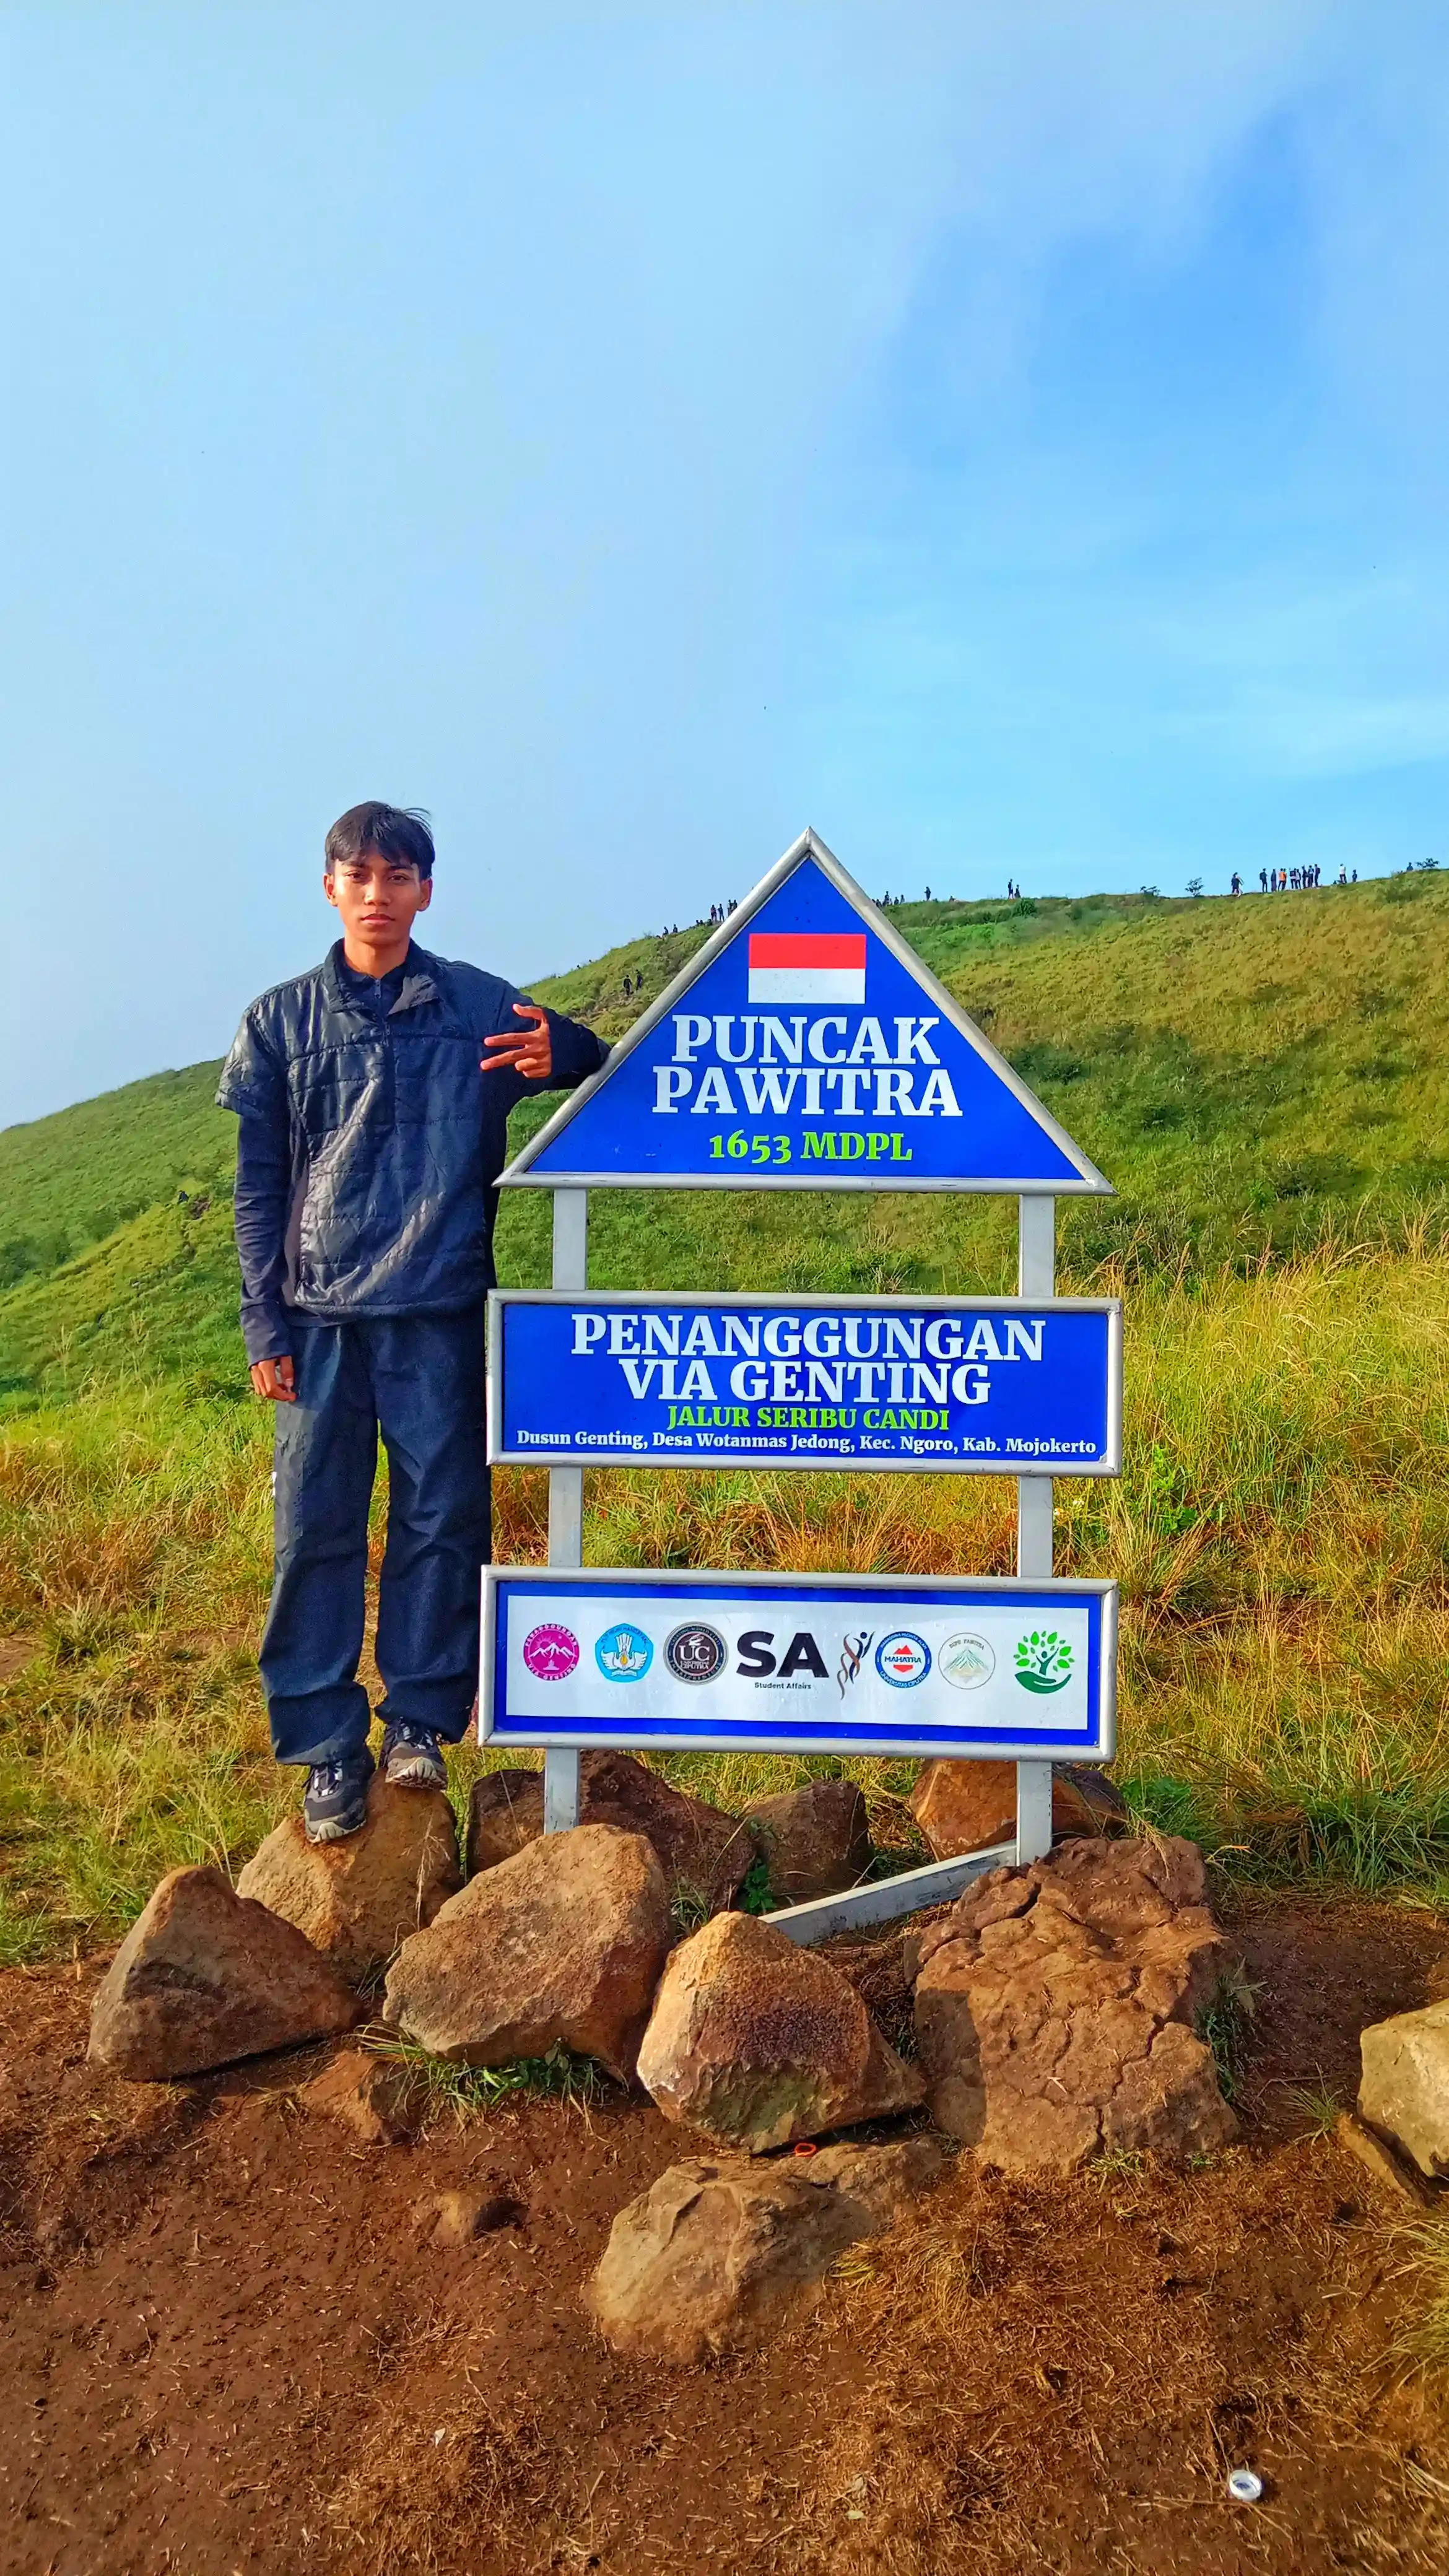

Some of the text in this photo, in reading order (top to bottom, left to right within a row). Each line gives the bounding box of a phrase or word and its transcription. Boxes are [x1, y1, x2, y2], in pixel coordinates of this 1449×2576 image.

[672, 1014, 941, 1065] PUNCAK
[652, 1066, 963, 1116] PAWITRA
[709, 1129, 913, 1164] 1653 MDPL
[571, 1313, 1046, 1361] PENANGGUNGAN
[618, 1359, 991, 1405] VIA GENTING
[666, 1405, 949, 1431] JALUR SERIBU CANDI
[516, 1430, 1097, 1456] Dusun Genting, Desa Wotanmas Jedong, Kec. Ngoro, Kab. Mojokerto
[679, 1645, 710, 1661] UC
[736, 1630, 830, 1678] SA
[884, 1656, 922, 1664] MAHATRA
